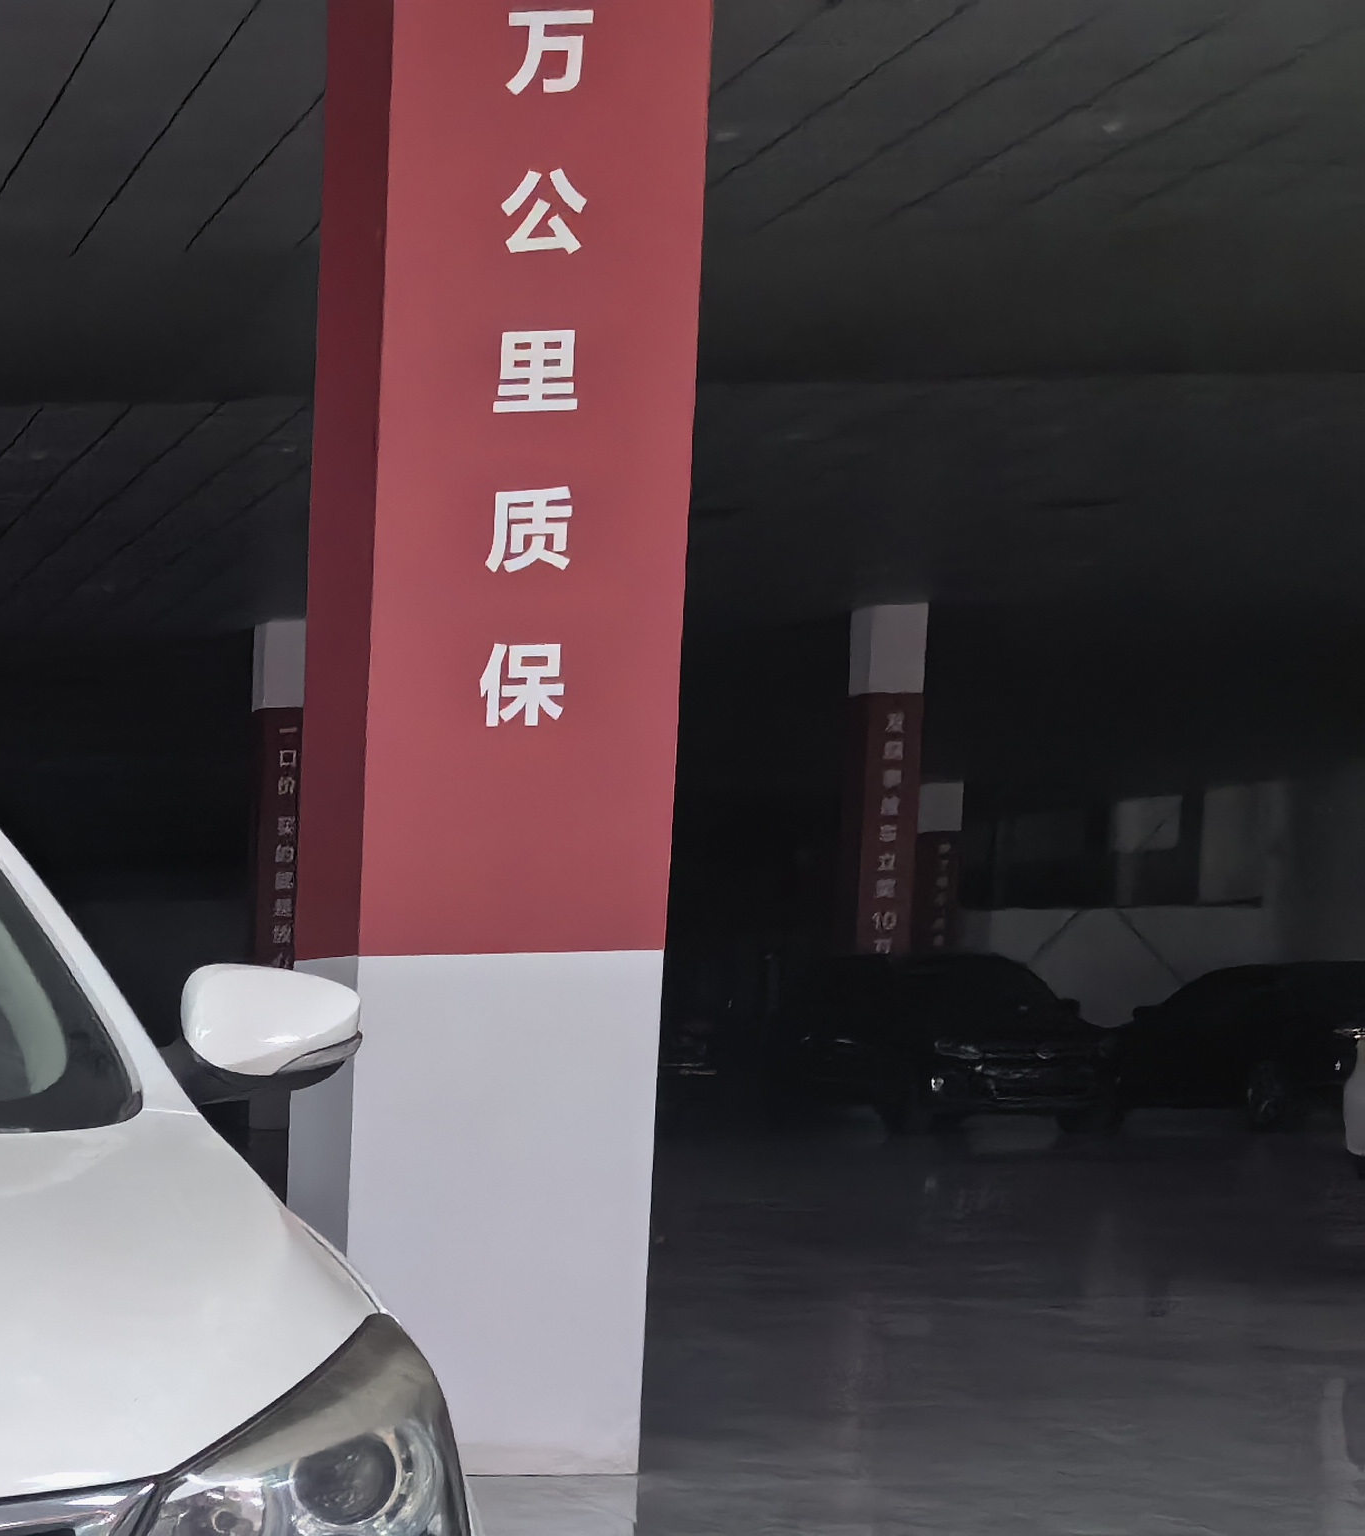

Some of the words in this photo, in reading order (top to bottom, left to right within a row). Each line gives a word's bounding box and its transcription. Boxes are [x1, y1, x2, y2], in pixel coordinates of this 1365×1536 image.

[478, 7, 595, 729] 万公里质保
